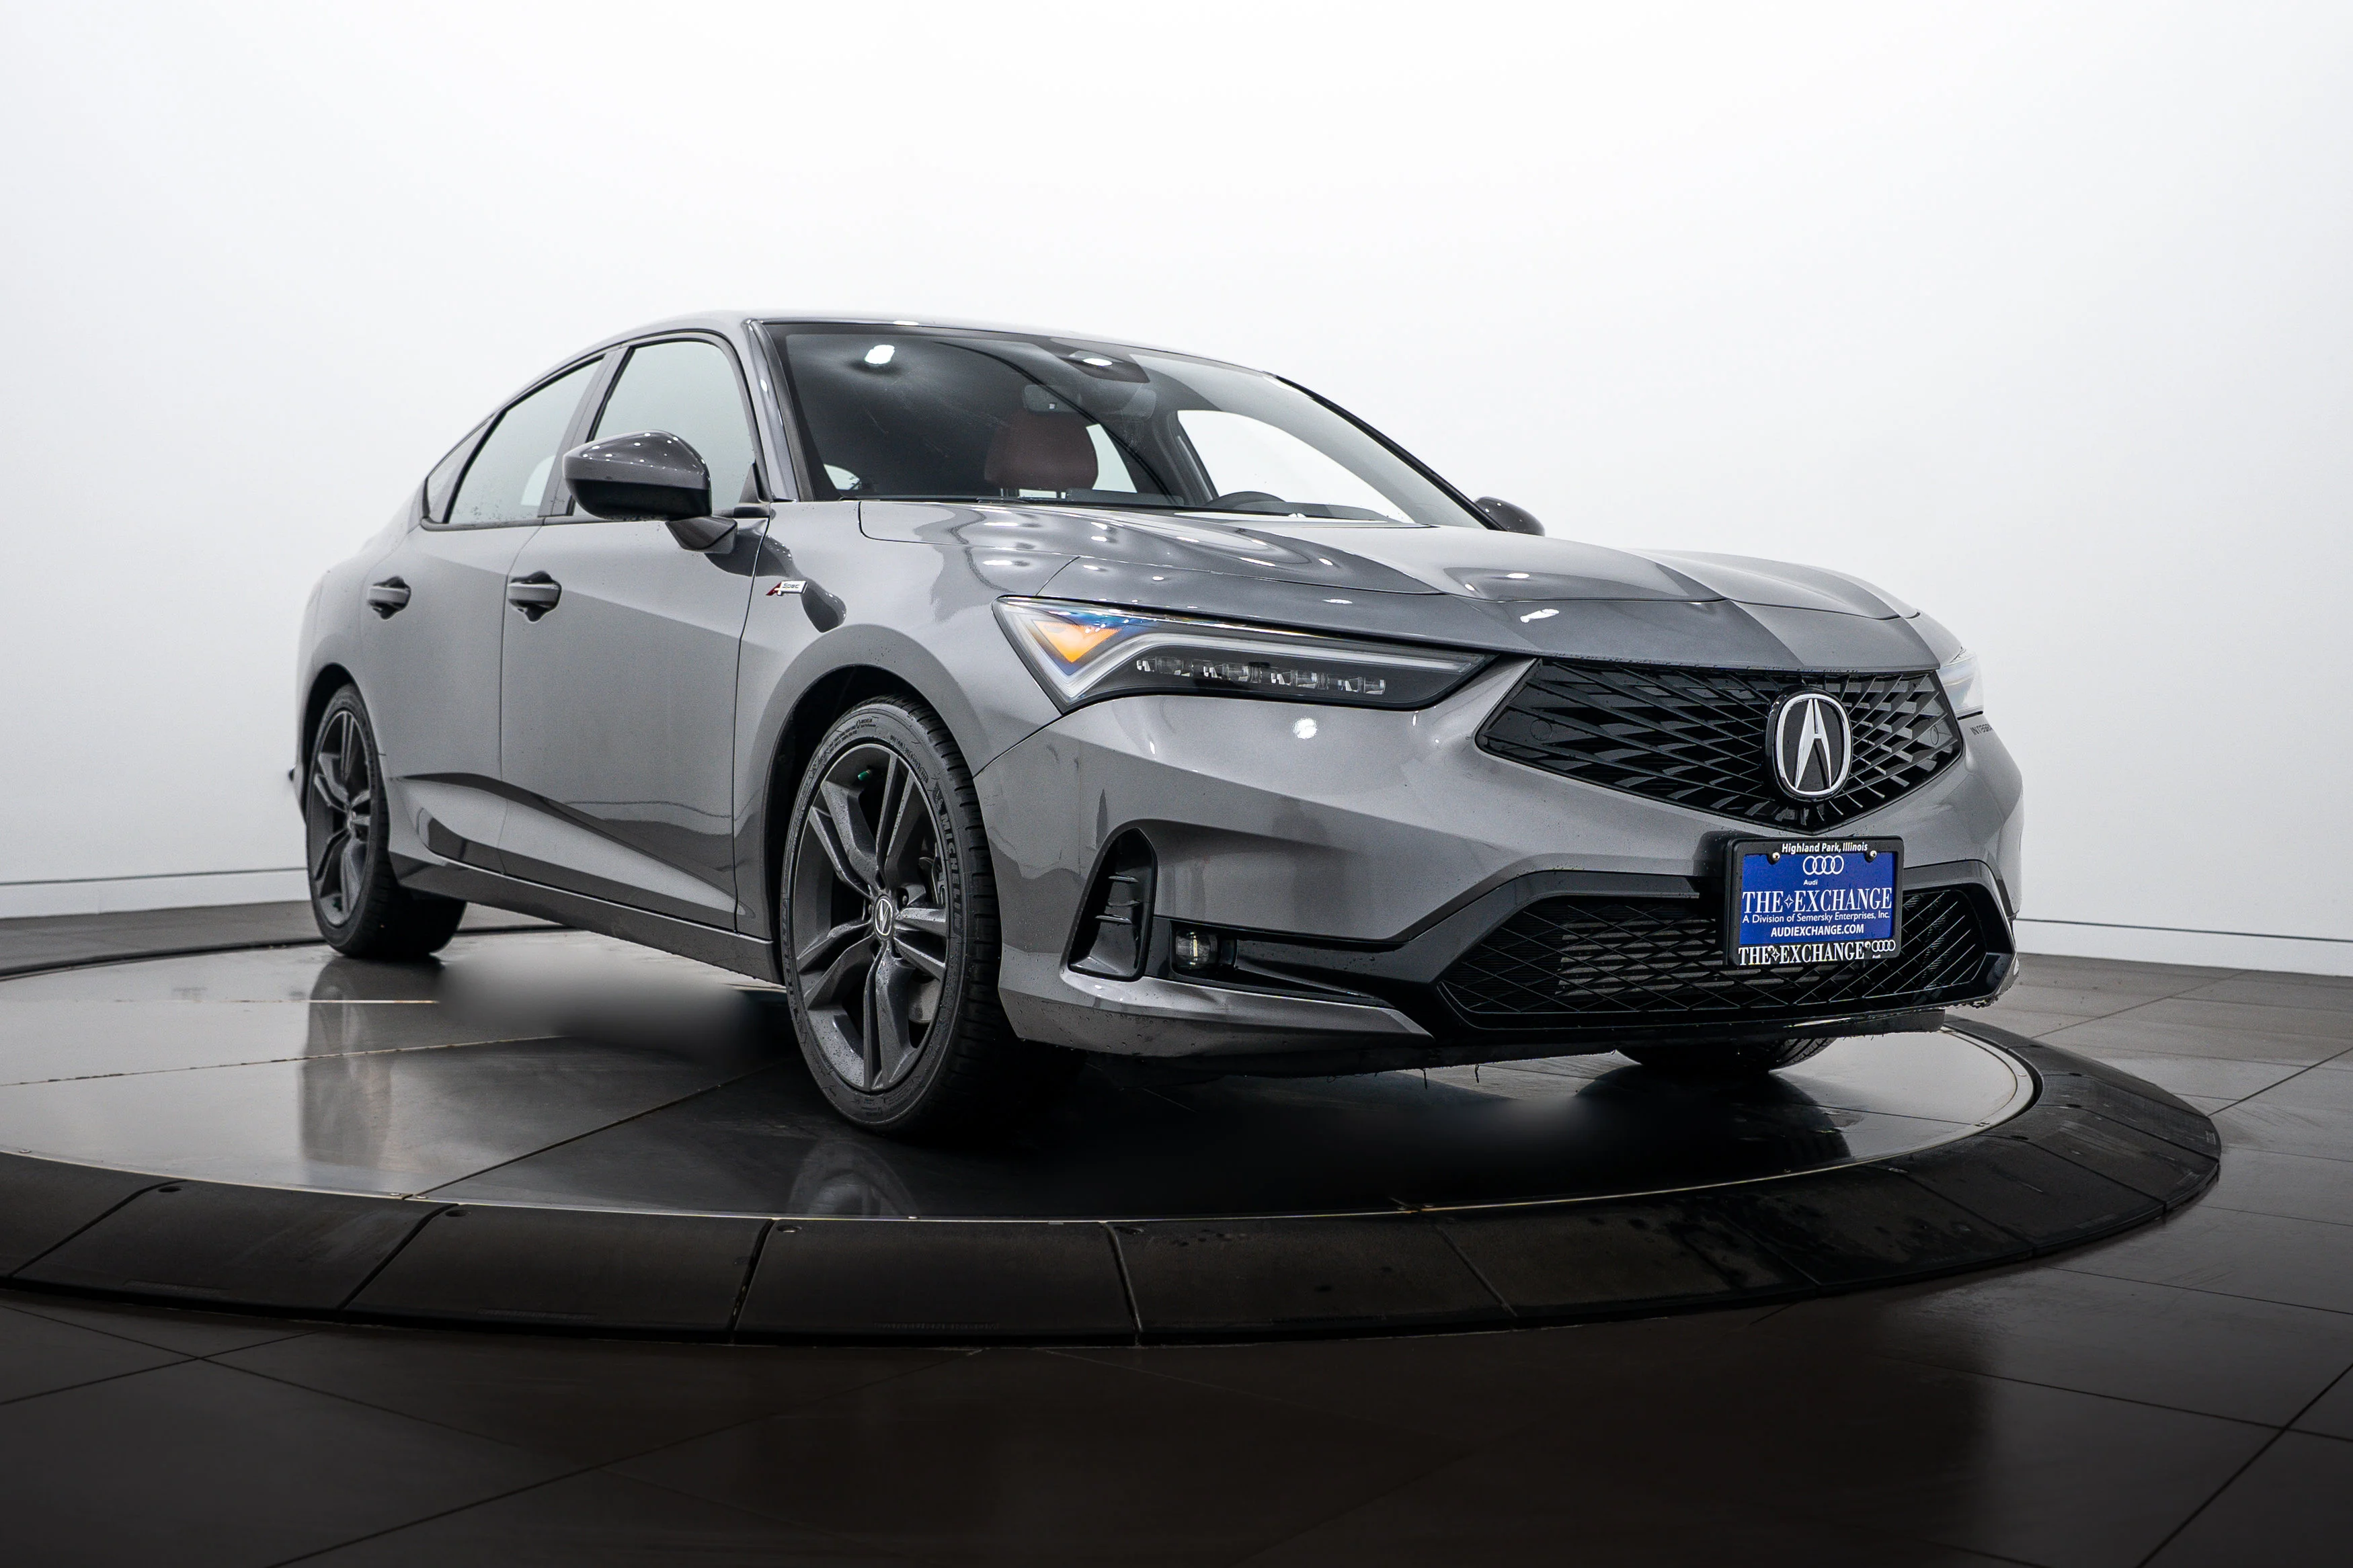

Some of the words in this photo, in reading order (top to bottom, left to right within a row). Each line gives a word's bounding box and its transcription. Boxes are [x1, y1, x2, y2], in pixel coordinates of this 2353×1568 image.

[1782, 842, 1820, 855] Highland
[1821, 842, 1841, 853] Park,
[1842, 841, 1868, 852] Illinois
[941, 813, 963, 930] MICHELIN
[1742, 891, 1784, 913] THE
[1793, 887, 1892, 912] EXCHANGE
[1742, 915, 1749, 923] A
[1752, 914, 1784, 923] Division
[1786, 913, 1796, 922] of
[1796, 913, 1833, 923] Semersky
[1834, 911, 1876, 921] Enterprises,
[1878, 910, 1890, 919] Inc.
[1770, 923, 1864, 938] AUDIEXCHANGE.COM
[1738, 946, 1771, 966] THE
[1779, 942, 1864, 964] EXCHANGE
